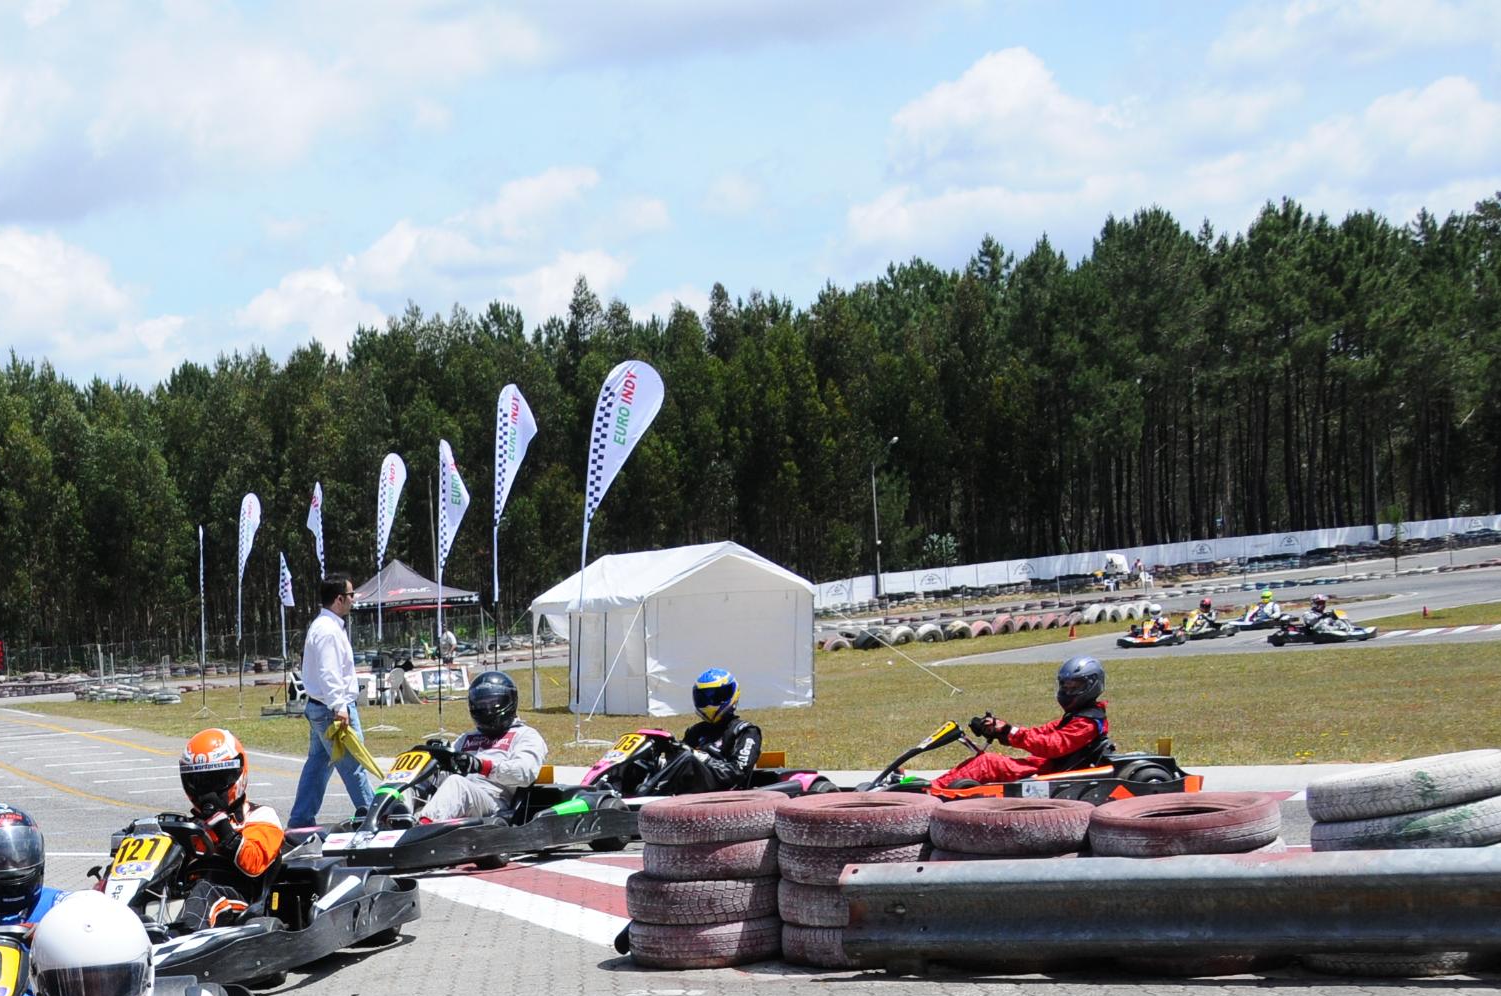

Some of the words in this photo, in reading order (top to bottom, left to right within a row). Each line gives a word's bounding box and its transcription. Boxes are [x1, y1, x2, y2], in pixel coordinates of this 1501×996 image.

[621, 370, 638, 405] INDY
[512, 395, 521, 425] INDY
[613, 406, 630, 445] EURO
[508, 427, 518, 461] EURO
[451, 474, 462, 506] EURO
[392, 754, 423, 771] 100
[117, 838, 161, 864] 127
